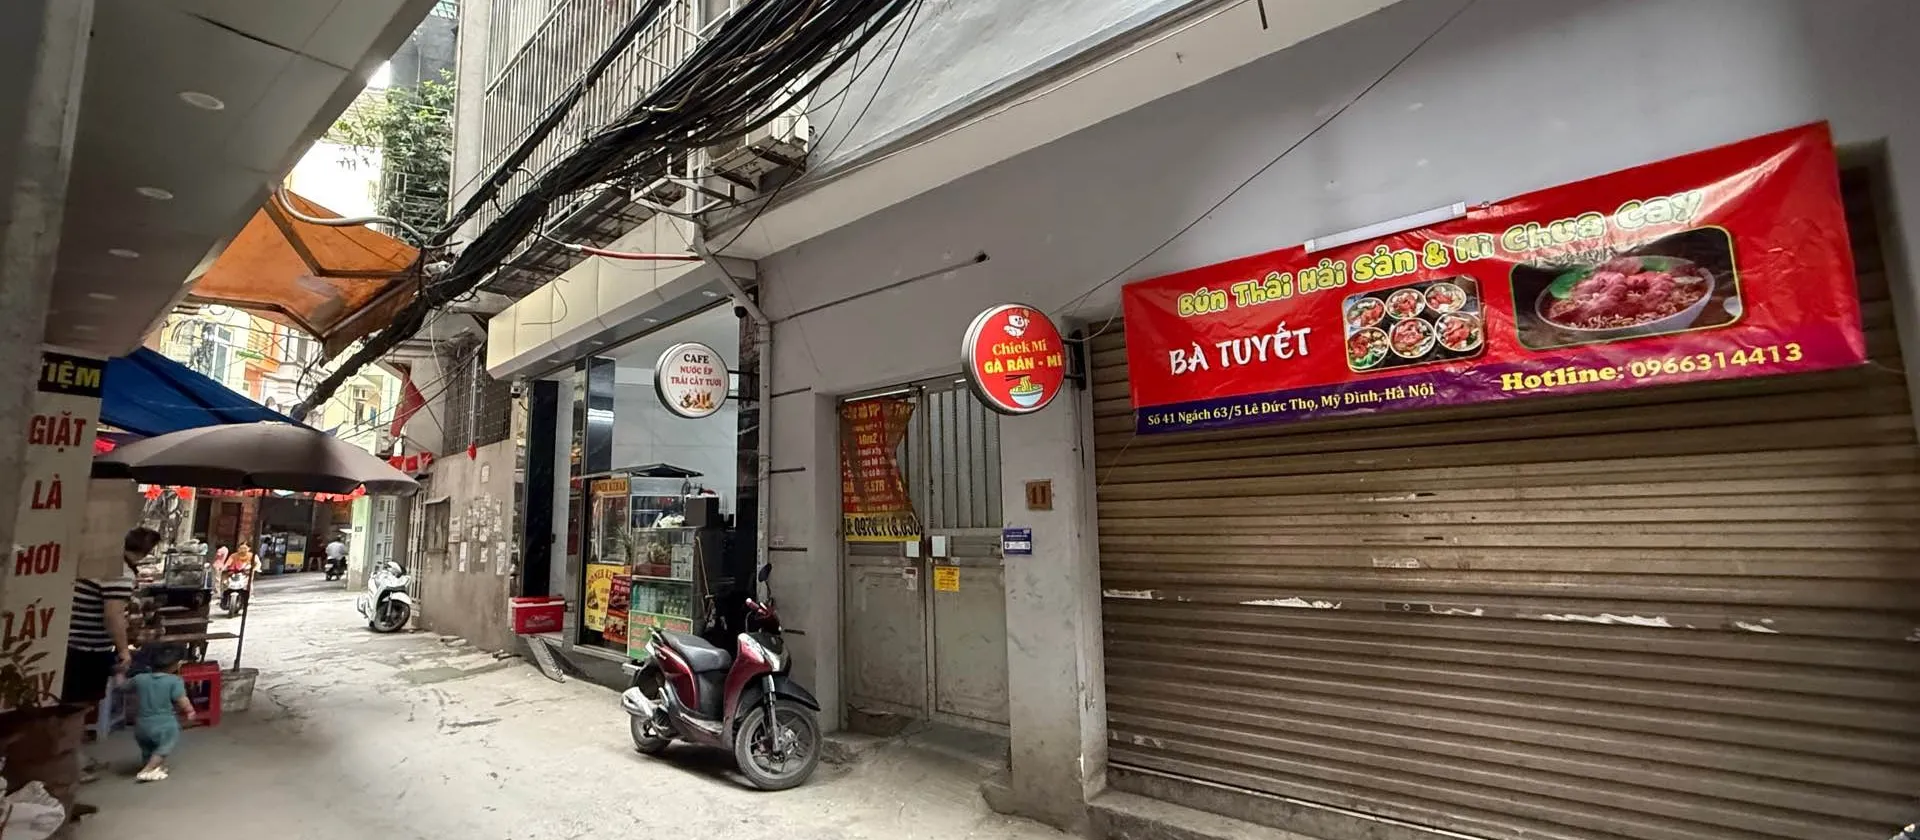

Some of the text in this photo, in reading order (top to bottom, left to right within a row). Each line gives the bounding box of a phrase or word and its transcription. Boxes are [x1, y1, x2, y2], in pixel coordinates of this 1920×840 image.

[1178, 288, 1228, 317] Bún
[1231, 272, 1294, 307] Thái
[1298, 258, 1348, 294] Hải
[1352, 245, 1417, 283] Sản
[1423, 240, 1448, 268] &
[1502, 212, 1608, 251] Chua
[1615, 191, 1703, 231] Cay
[683, 353, 710, 364] CAFE
[984, 358, 1004, 374] GÀ
[1006, 355, 1035, 371] RÁN
[992, 340, 1031, 355] Chick
[1168, 321, 1311, 375] BÀ TUYẾT
[42, 357, 102, 389] IỆM
[1500, 343, 1803, 391] Hotline: 0966314413
[1148, 382, 1435, 426] Số 41 Ngách 63/5 Lê Đức Thọ, Mỹ Đình, Hà Nội
[28, 411, 86, 453] GIẶT
[31, 474, 62, 509] LÀ
[15, 541, 61, 576] HƠI
